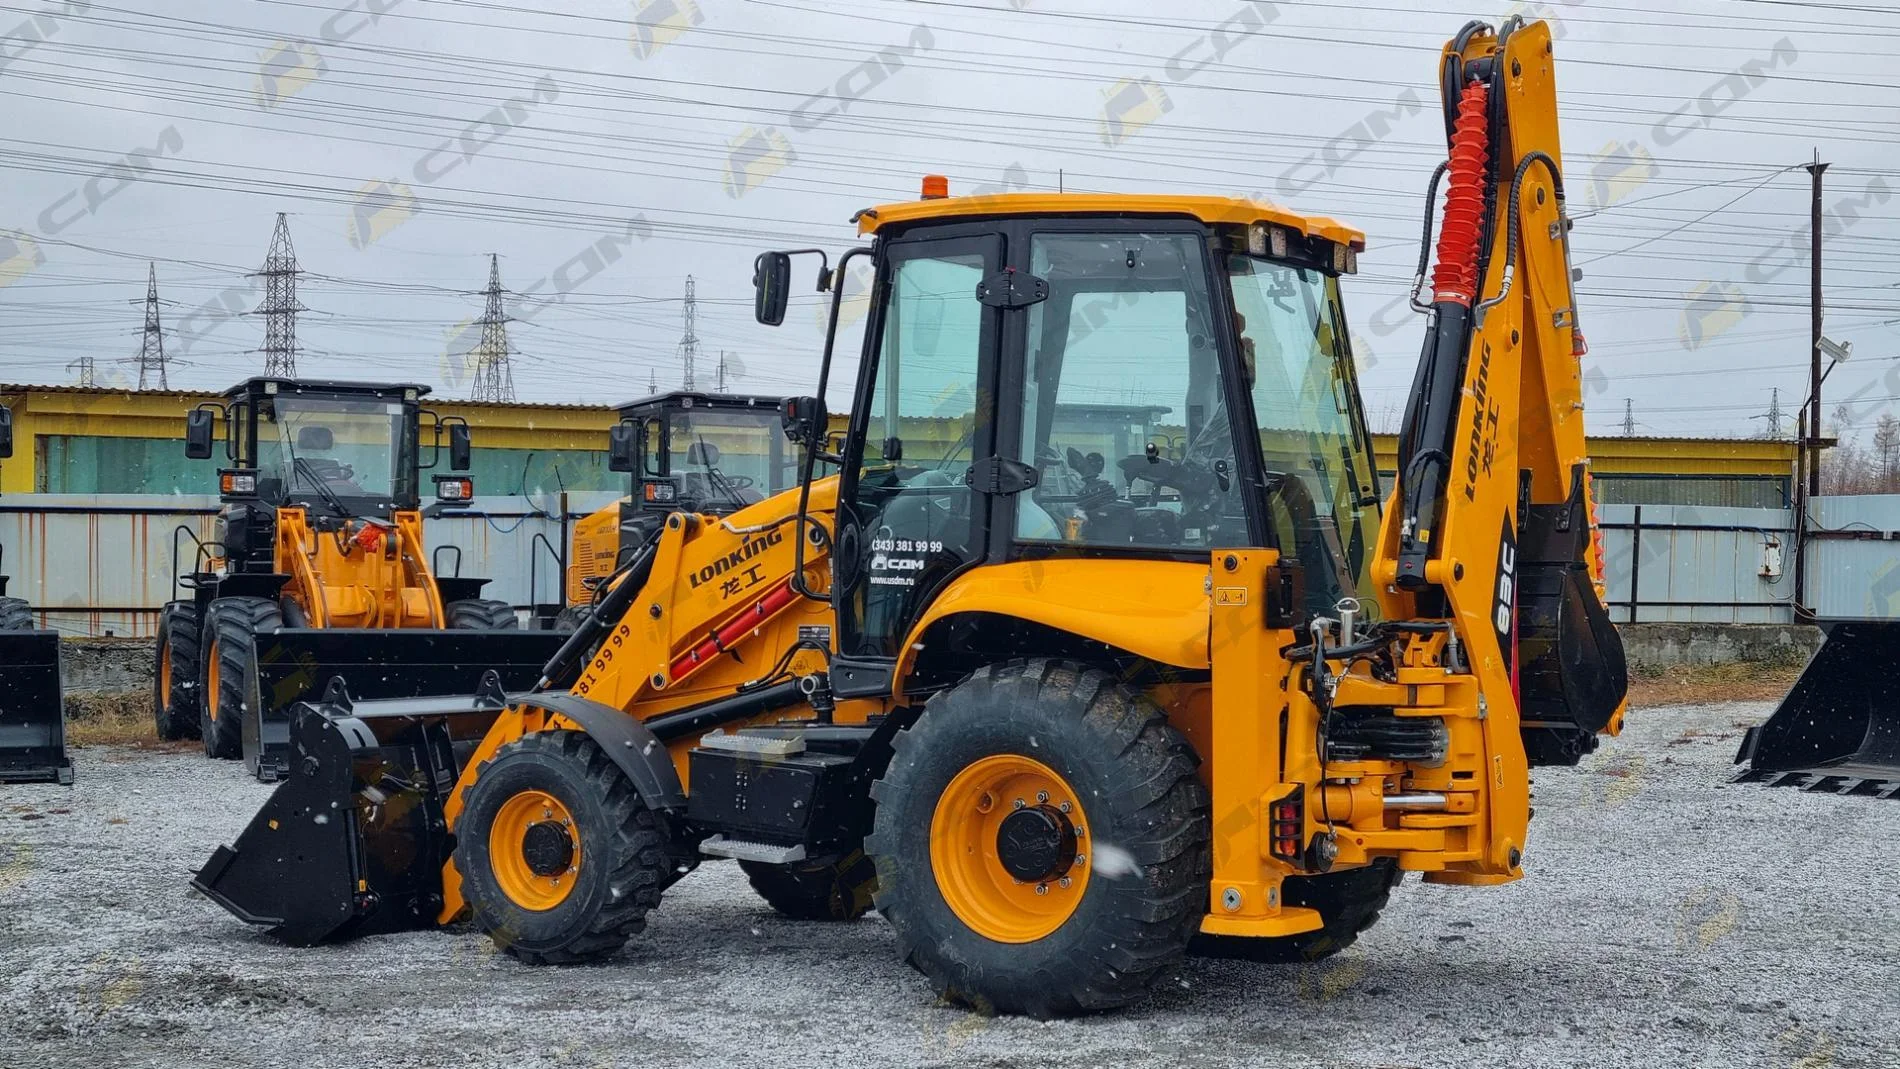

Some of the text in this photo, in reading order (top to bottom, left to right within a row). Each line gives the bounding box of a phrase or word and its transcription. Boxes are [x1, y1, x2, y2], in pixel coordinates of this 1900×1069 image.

[871, 539, 943, 553] (343) 381 99 99
[870, 576, 915, 586] www.usdm.ru
[571, 624, 630, 697] 81 99 99
